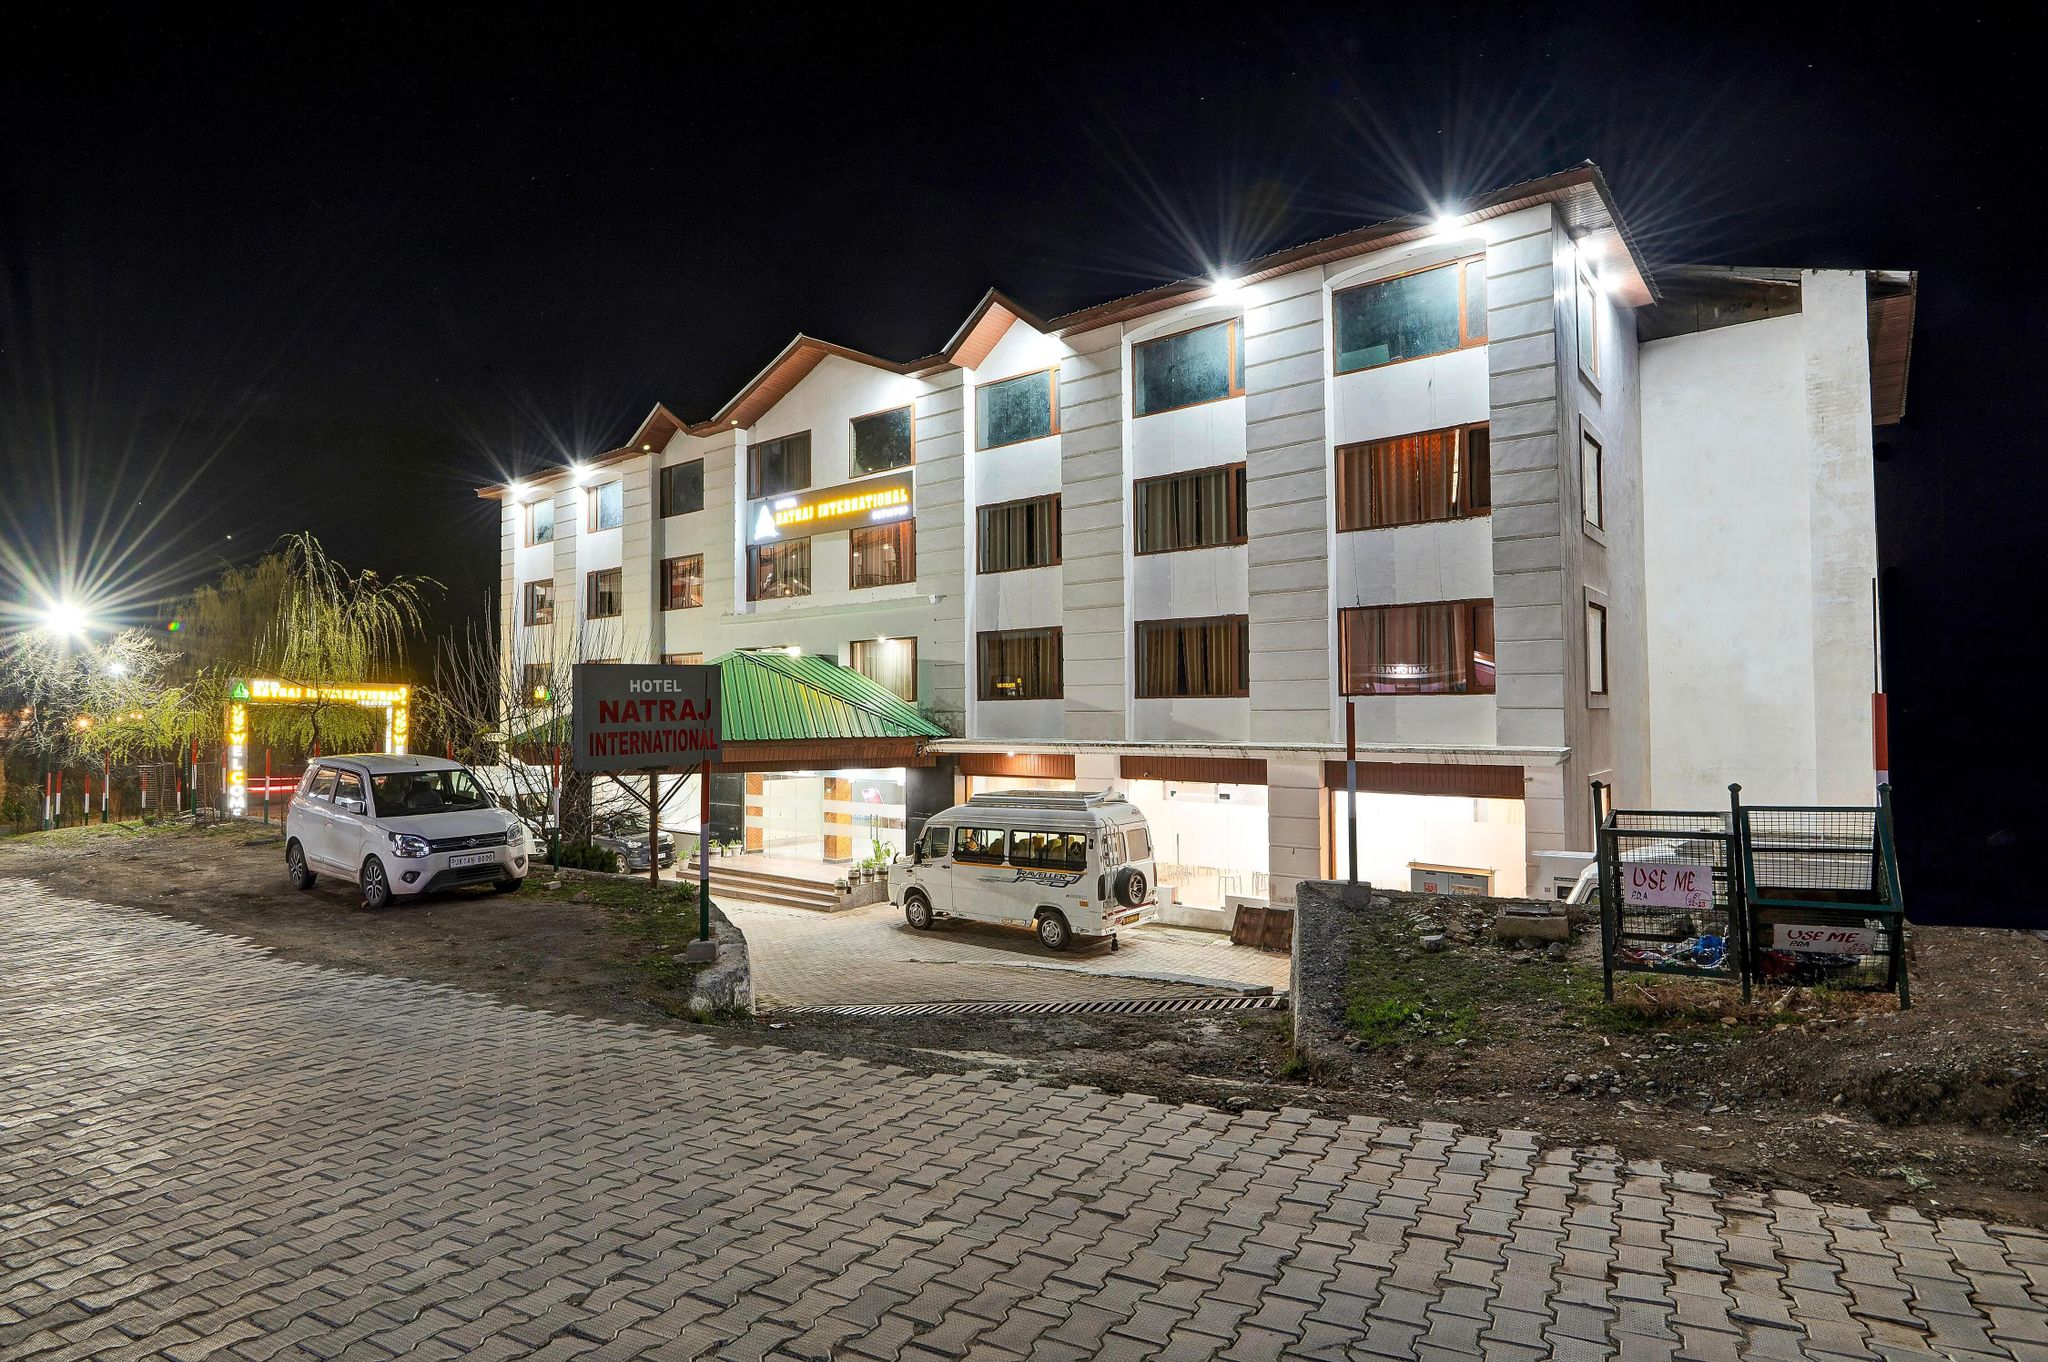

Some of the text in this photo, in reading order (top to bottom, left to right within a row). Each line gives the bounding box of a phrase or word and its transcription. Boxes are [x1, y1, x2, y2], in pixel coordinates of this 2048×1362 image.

[776, 506, 814, 525] NATRAJ
[818, 489, 908, 518] INTERNATIONAL
[630, 680, 682, 693] HOTEL
[599, 699, 711, 723] NATRAJ
[589, 728, 718, 757] INTERNATIONAL
[1016, 868, 1067, 880] TRAVELLER
[1633, 867, 1696, 891] USE ME
[1787, 929, 1859, 943] USE ME
